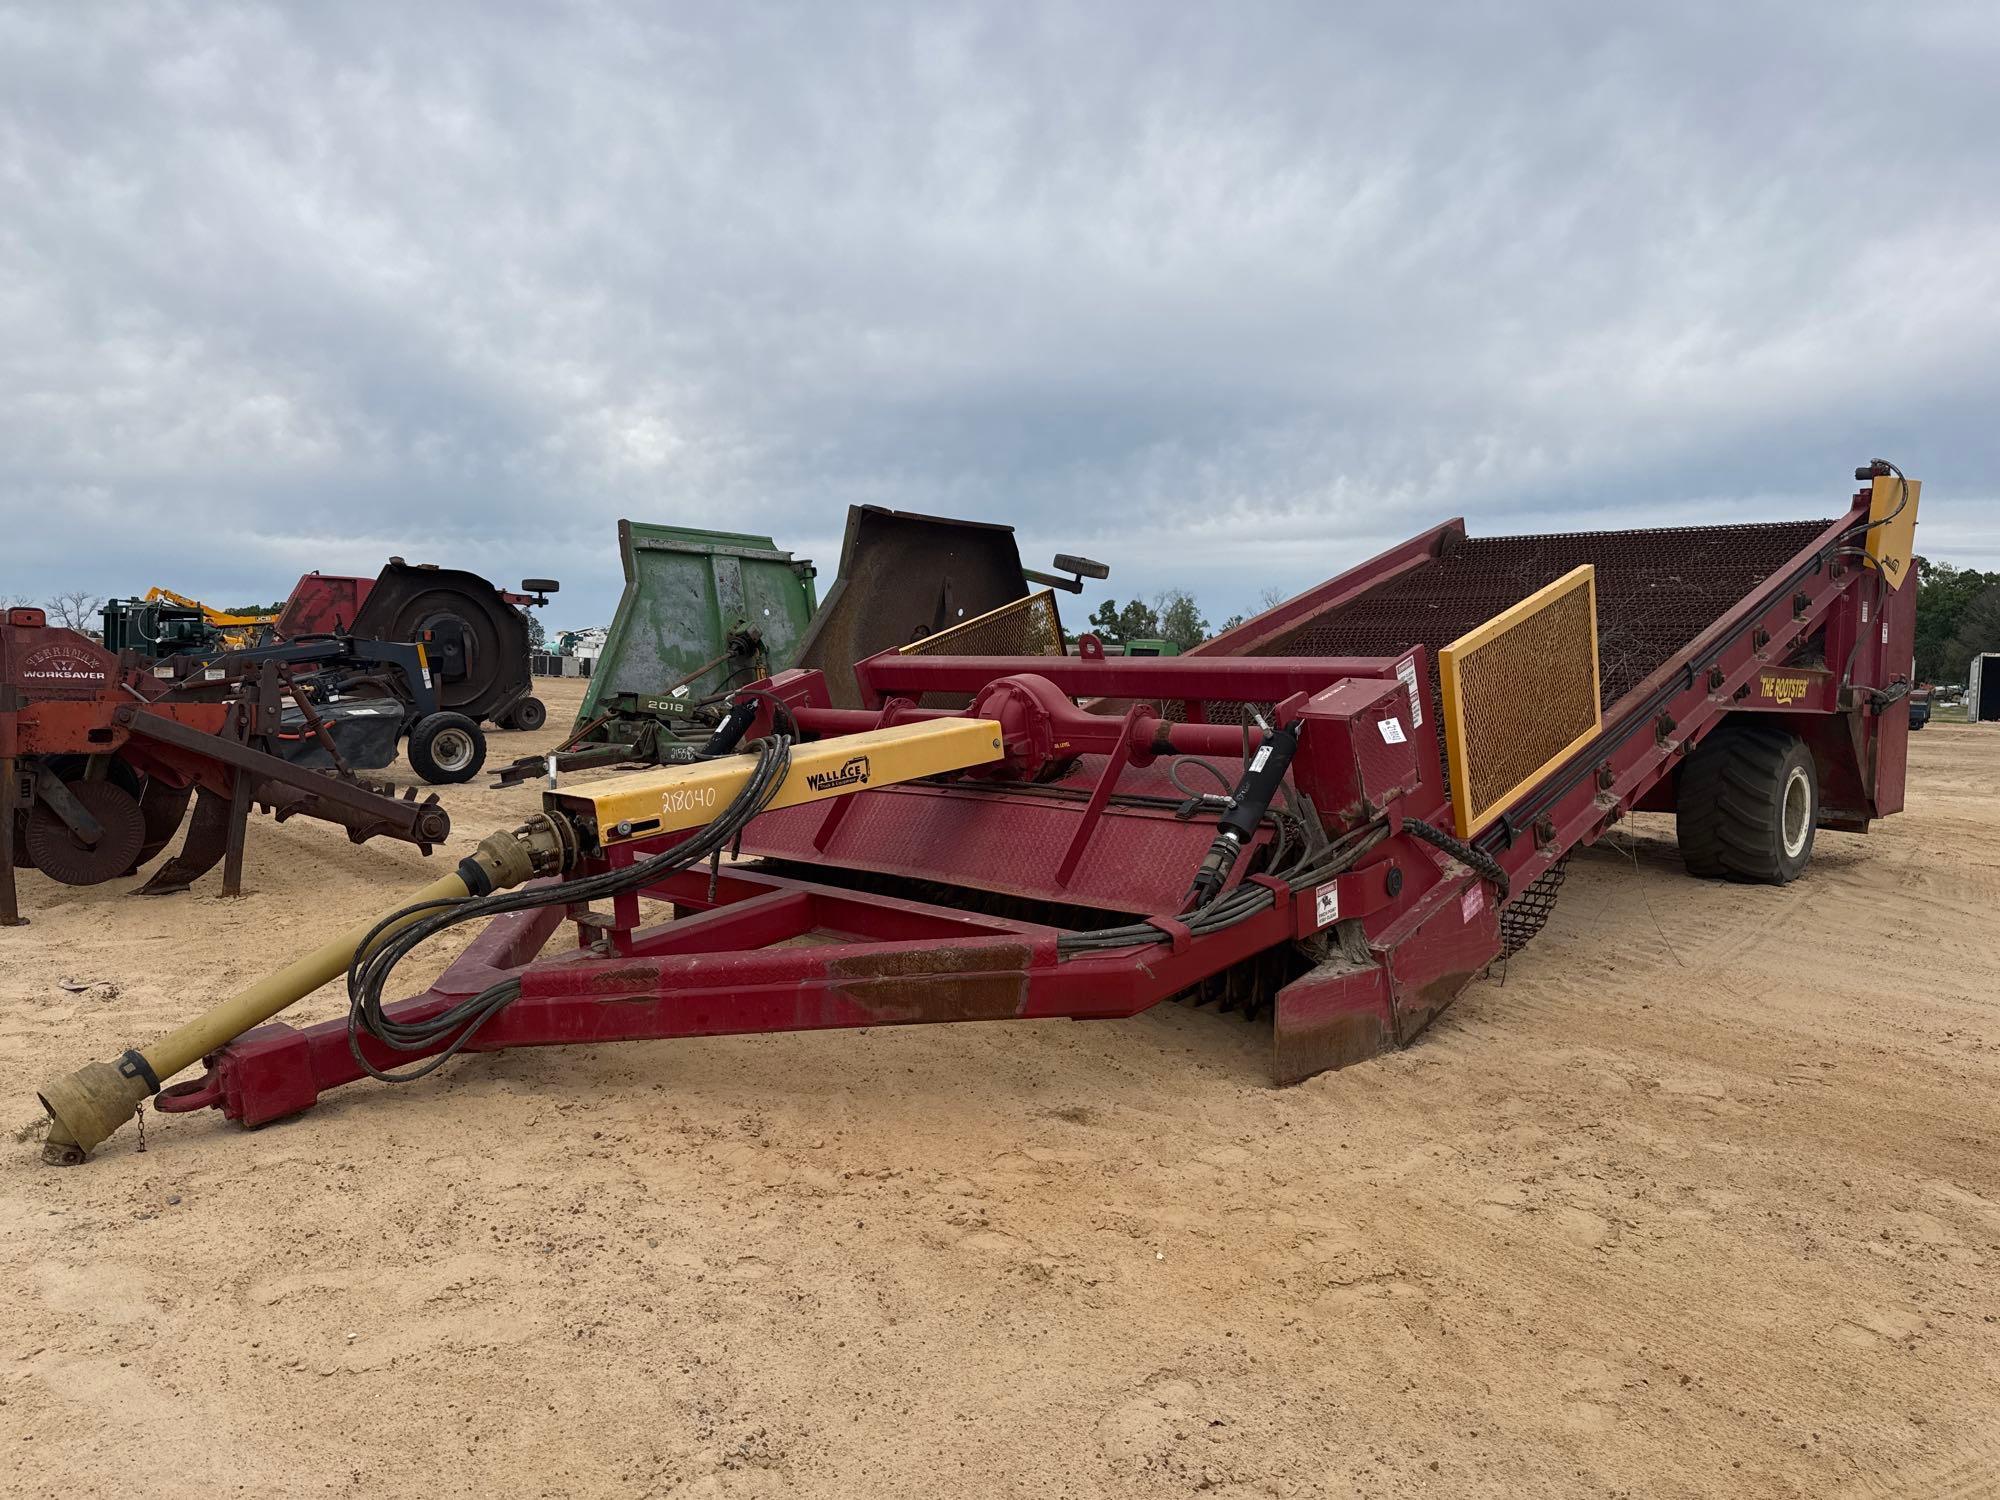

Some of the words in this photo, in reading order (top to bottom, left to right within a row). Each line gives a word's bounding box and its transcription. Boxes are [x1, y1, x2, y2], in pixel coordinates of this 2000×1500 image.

[23, 671, 105, 679] WORKSAVER
[647, 700, 684, 712] 2018
[806, 764, 862, 791] WALLACE
[661, 787, 716, 813] 218040
